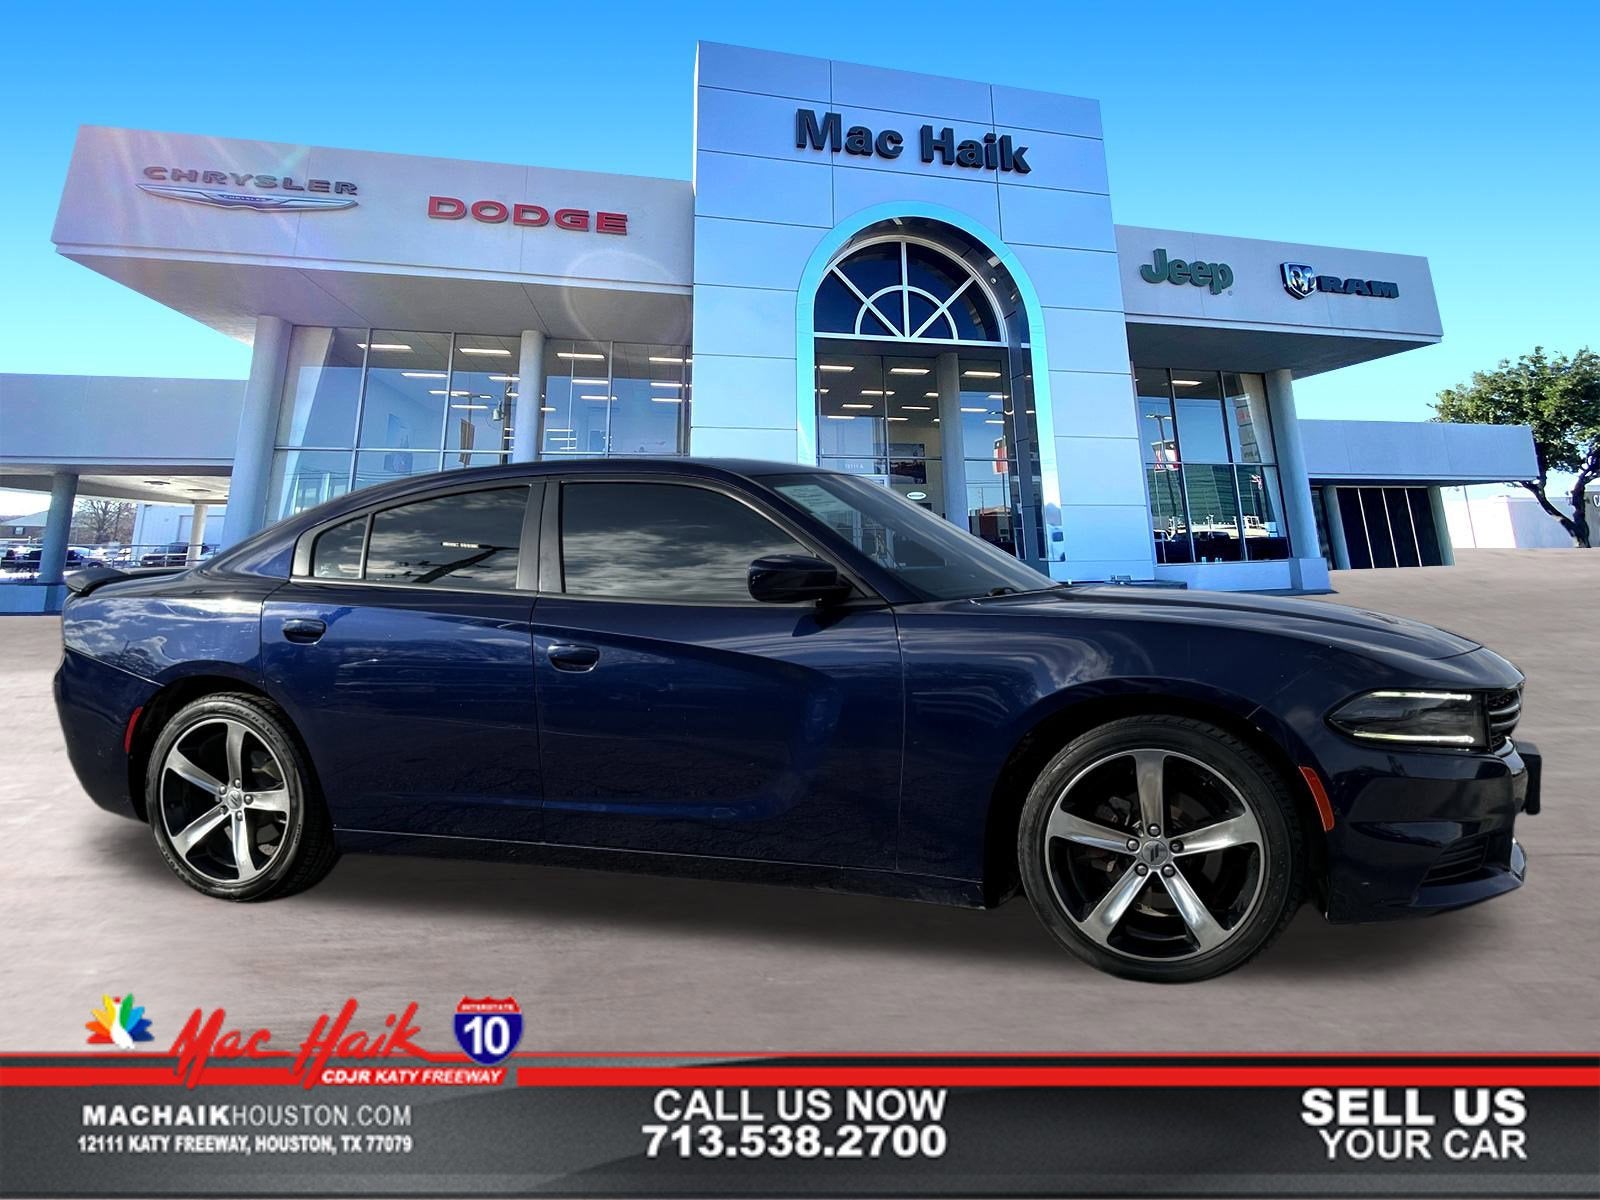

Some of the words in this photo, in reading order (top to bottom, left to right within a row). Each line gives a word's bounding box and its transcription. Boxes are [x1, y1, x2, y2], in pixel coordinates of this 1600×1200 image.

[795, 108, 904, 160] Mac
[920, 124, 1032, 174] Haik
[143, 166, 358, 196] CHRYSLER
[427, 195, 628, 235] DODGE
[1139, 248, 1234, 296] Jeep
[1316, 275, 1400, 299] RAM
